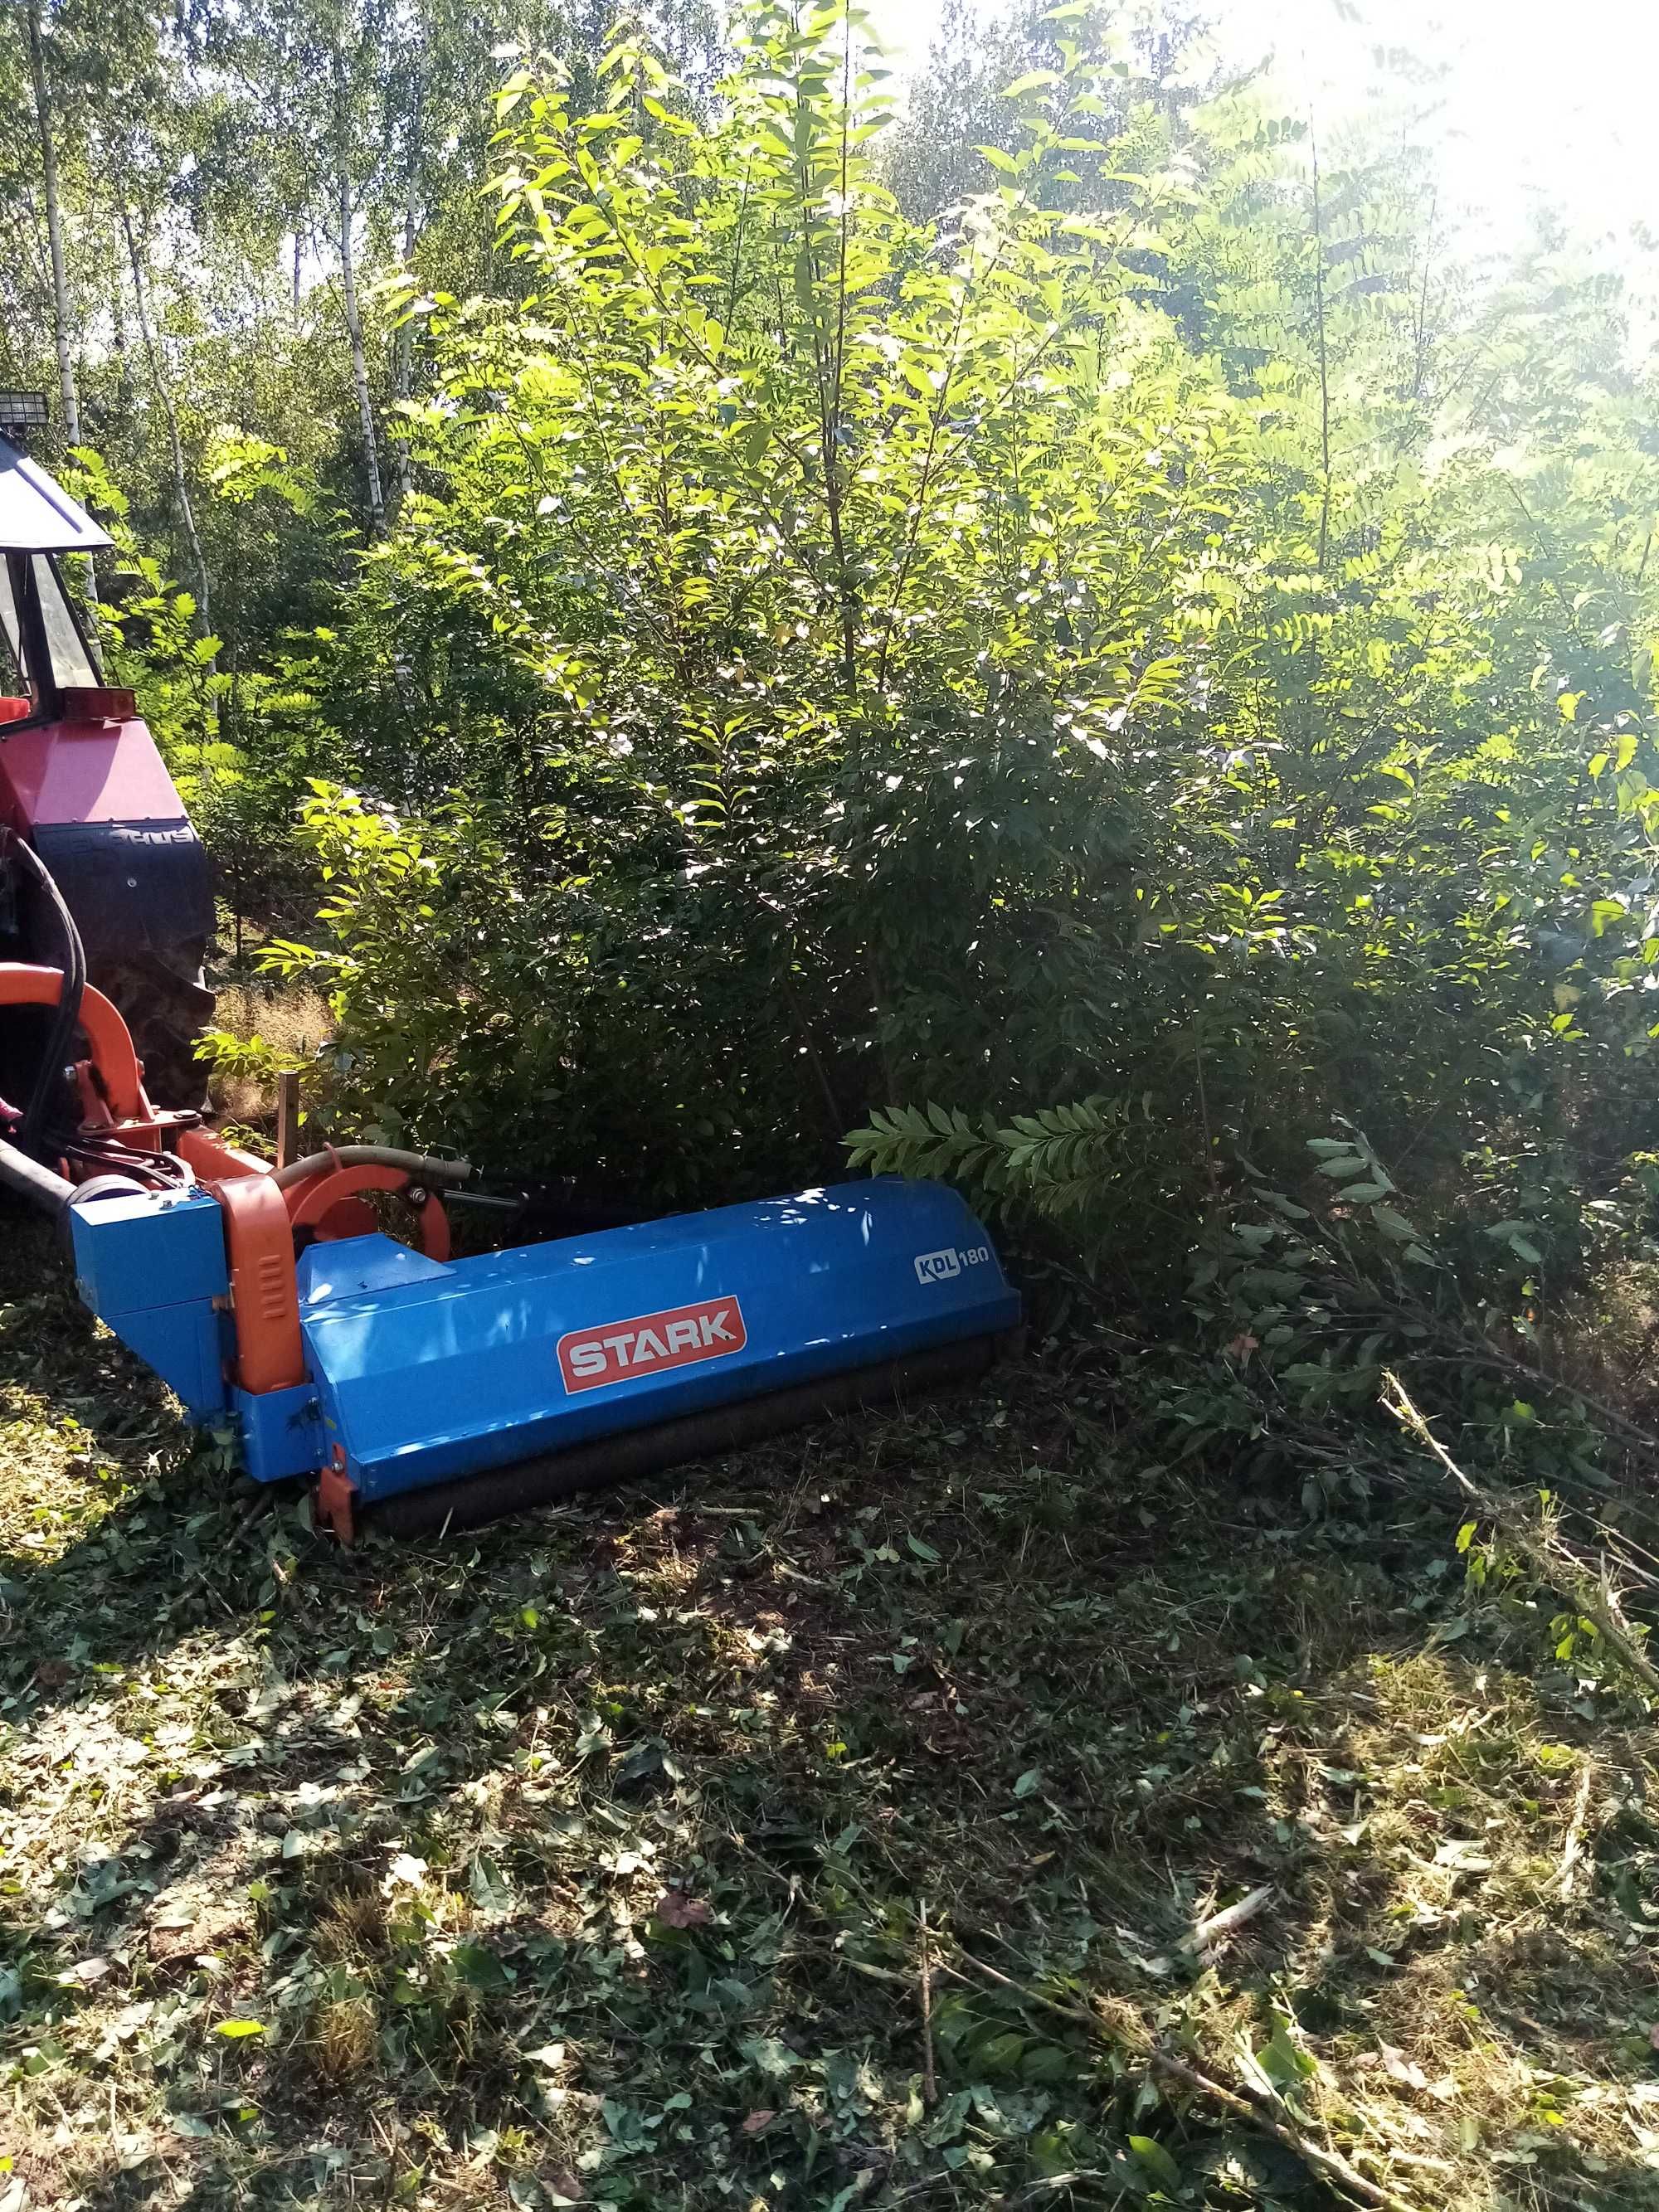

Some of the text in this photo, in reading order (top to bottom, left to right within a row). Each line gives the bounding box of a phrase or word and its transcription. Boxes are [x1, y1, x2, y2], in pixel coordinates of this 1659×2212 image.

[919, 1247, 990, 1280] KDL 180
[569, 1310, 737, 1378] STARK
